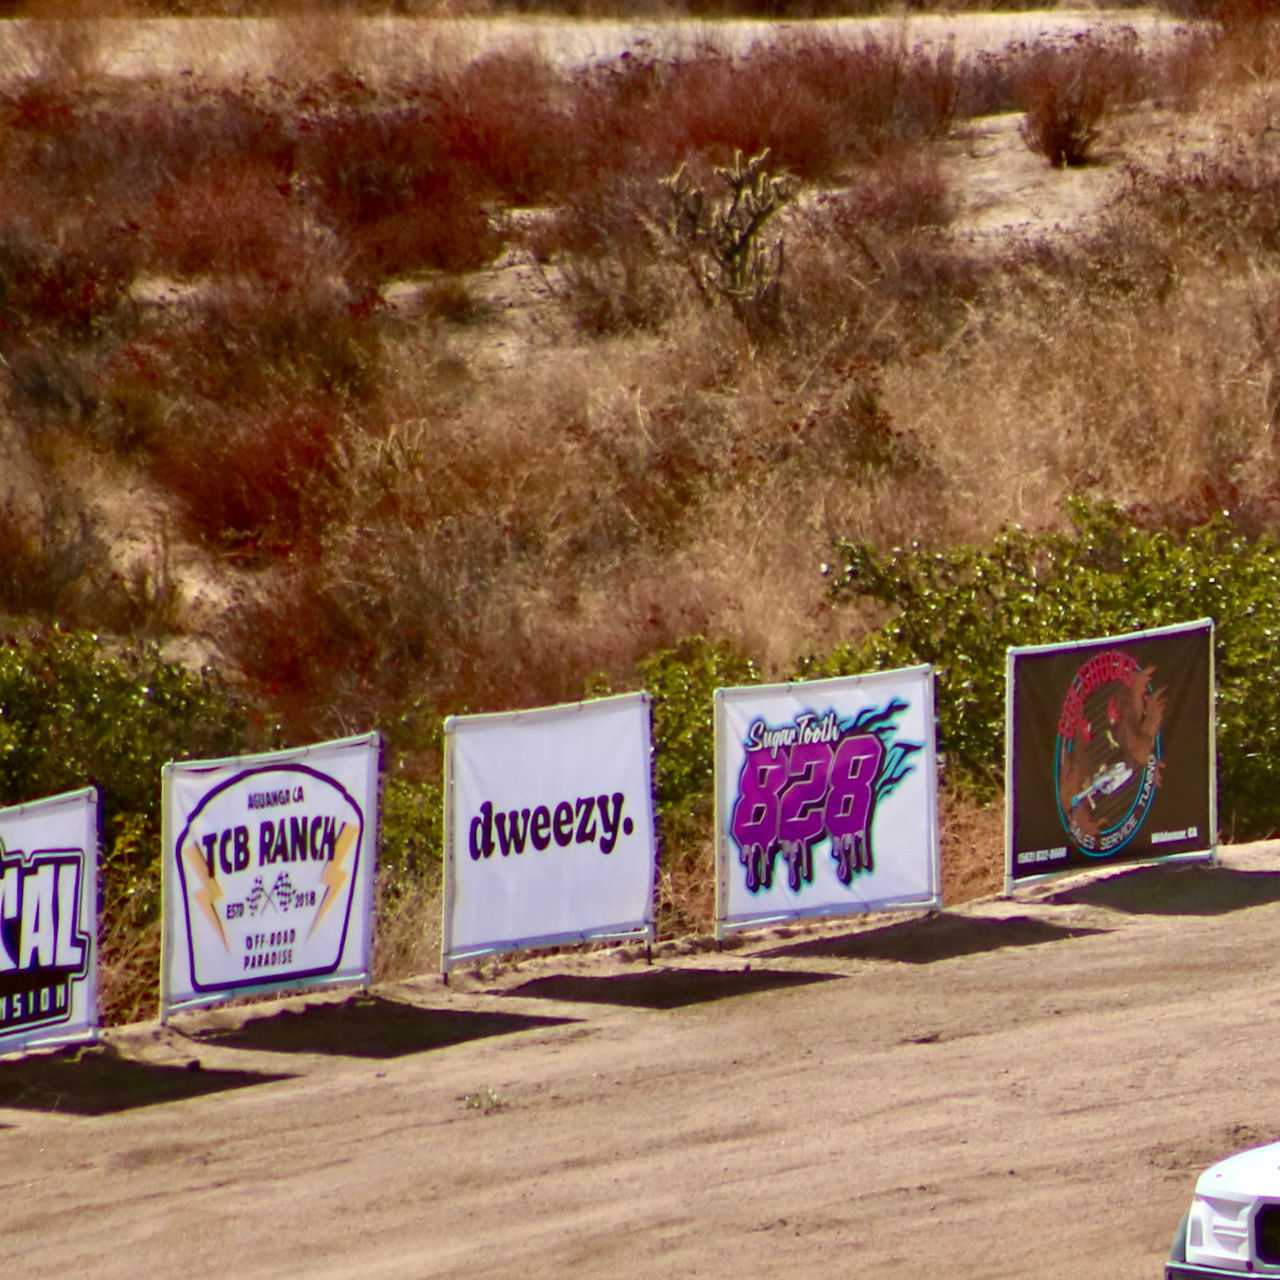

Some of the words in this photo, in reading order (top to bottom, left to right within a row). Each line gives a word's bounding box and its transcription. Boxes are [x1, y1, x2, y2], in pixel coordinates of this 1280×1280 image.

[747, 719, 796, 760] Sugar
[795, 711, 840, 745] Tooth
[731, 733, 885, 865] 828
[1138, 754, 1157, 807] TUNING
[202, 825, 250, 878] TCB
[259, 816, 337, 867] RANCH
[468, 791, 635, 861] dweezy.
[1100, 814, 1138, 850] SERVICE
[294, 891, 317, 909] 2018
[243, 949, 294, 971] PARADISE
[245, 928, 296, 951] OFF-ROAD
